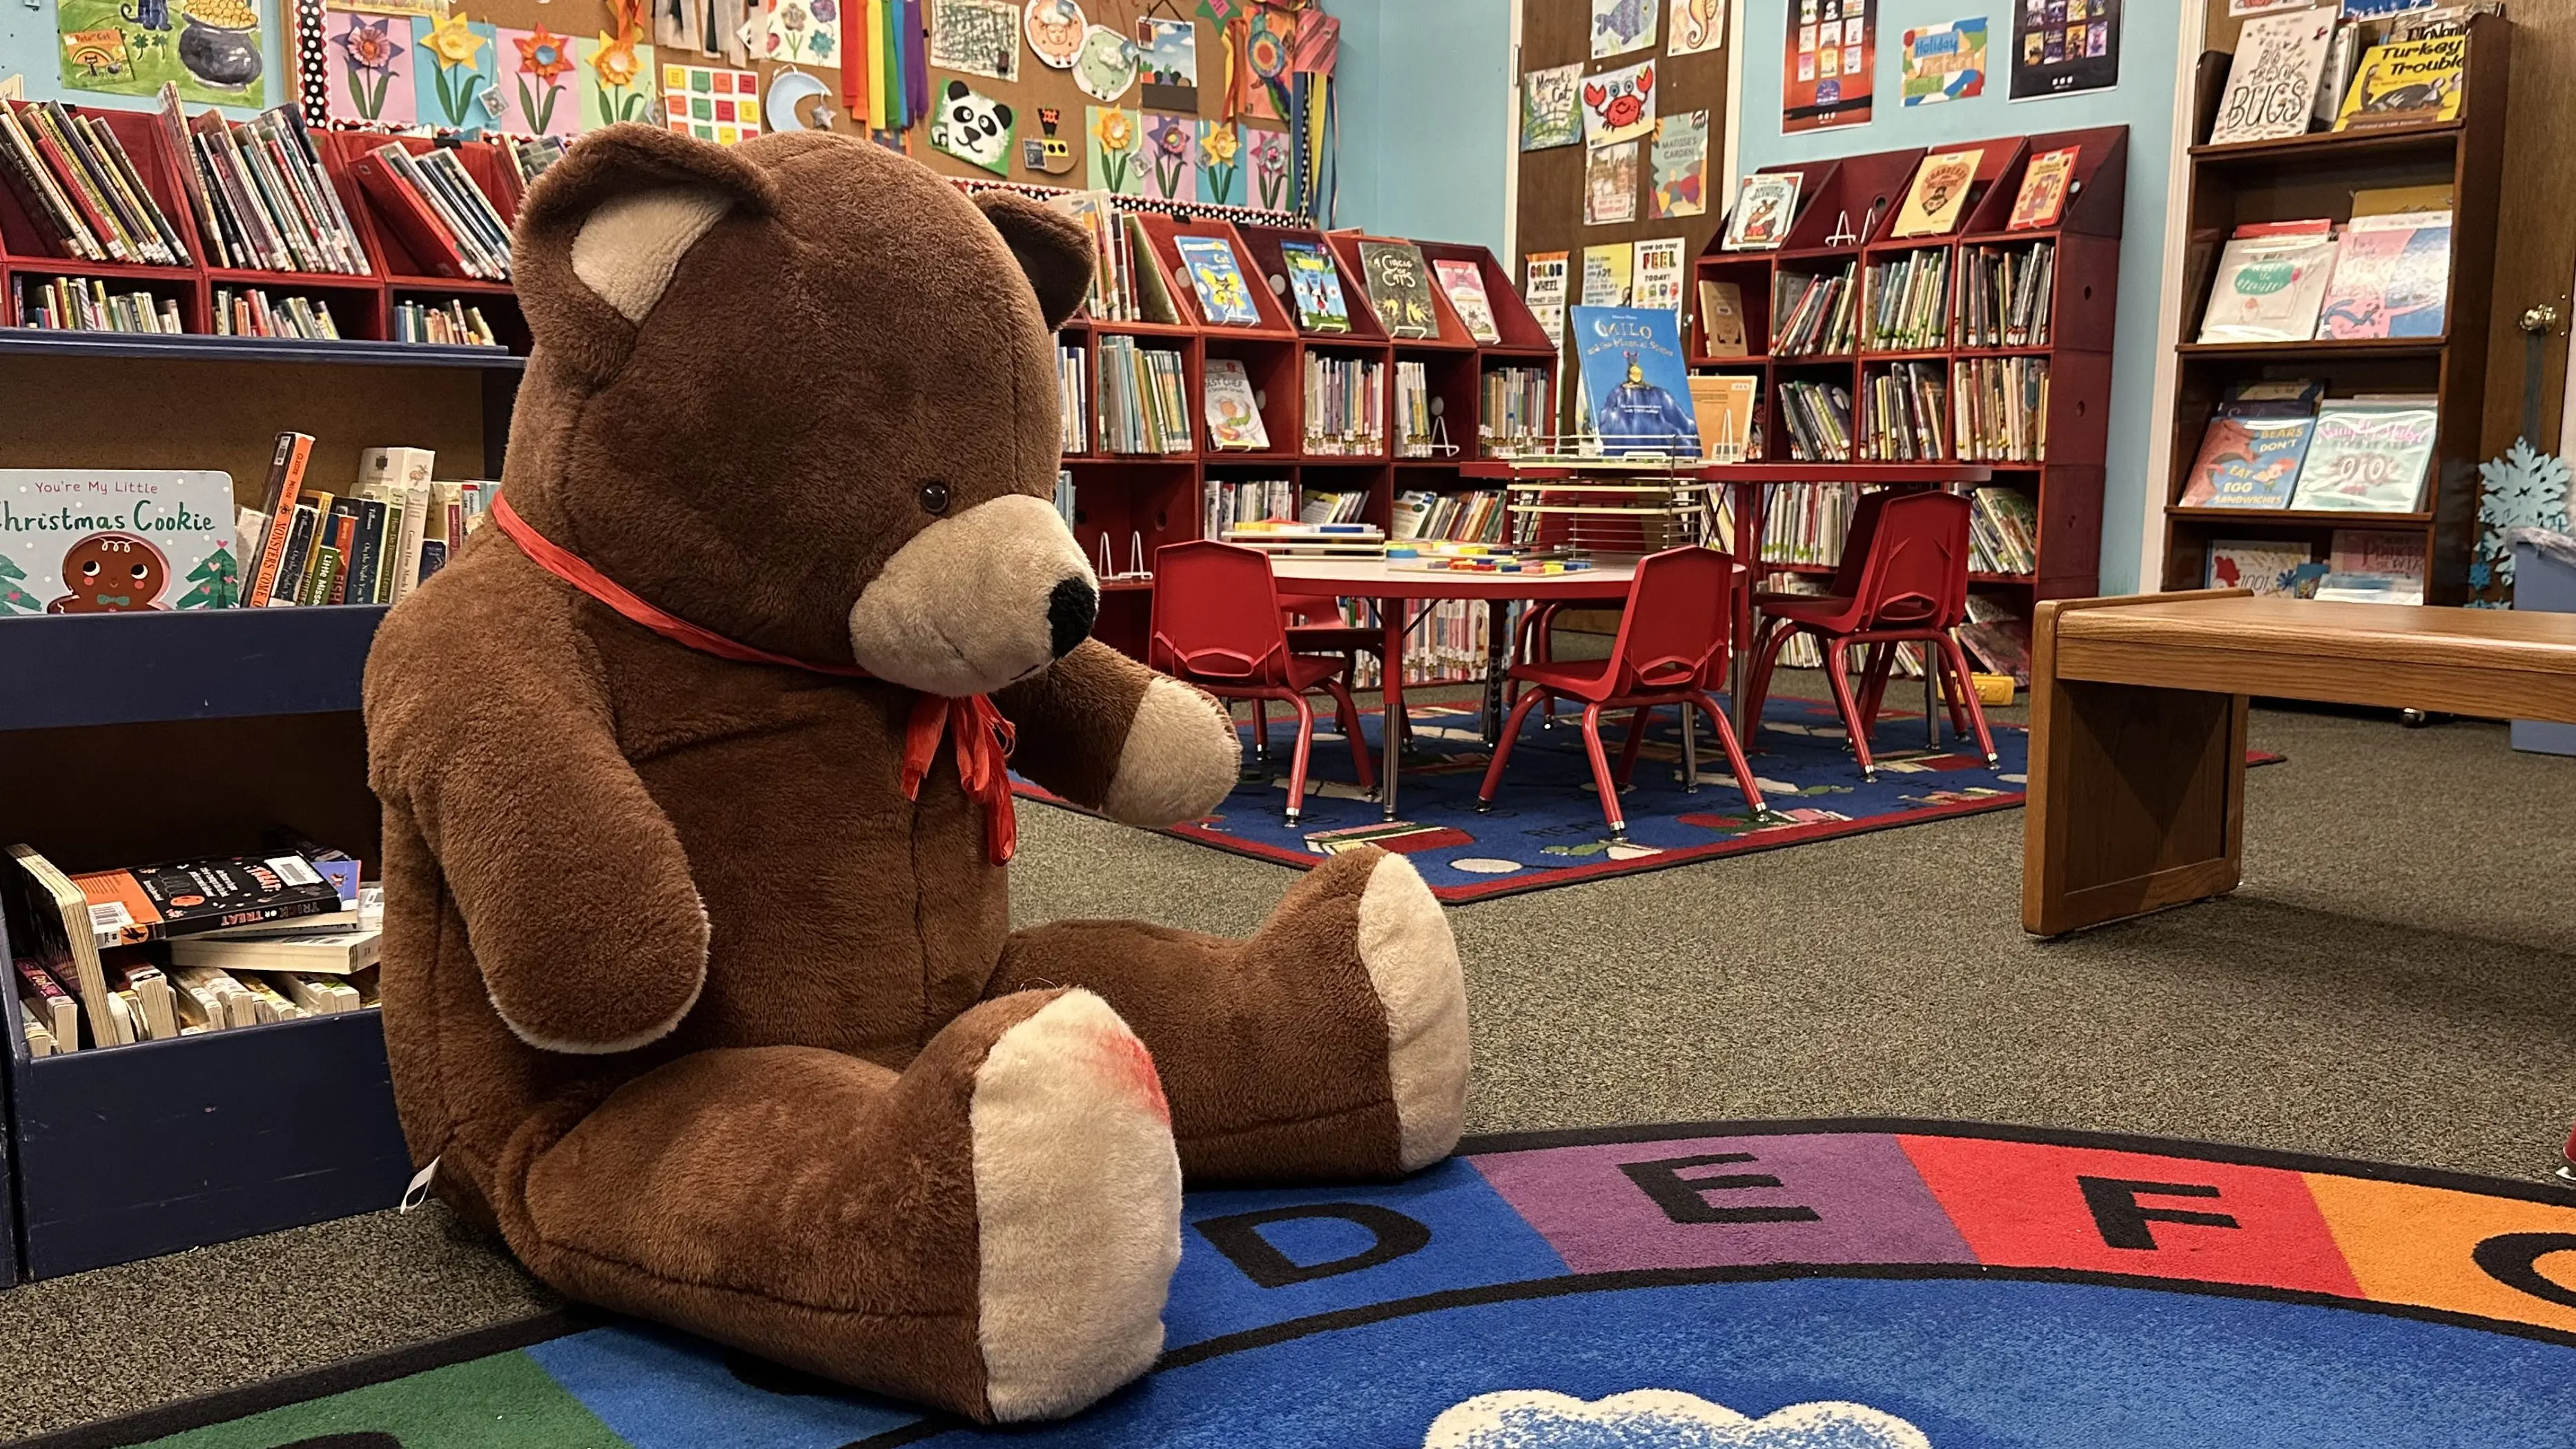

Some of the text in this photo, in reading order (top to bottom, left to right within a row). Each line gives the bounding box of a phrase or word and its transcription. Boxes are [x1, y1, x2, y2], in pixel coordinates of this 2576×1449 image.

[1915, 36, 1958, 57] Holiday
[2382, 39, 2463, 59] Turkey
[1551, 84, 1572, 103] Cat
[2226, 79, 2307, 129] BUGS
[1643, 251, 1677, 270] FEEL
[1530, 263, 1563, 278] COLOR
[1534, 280, 1559, 293] WHEEL
[1594, 320, 1652, 340] MILO
[2261, 427, 2303, 440] BEARS
[2259, 439, 2297, 453] DON'T
[2229, 465, 2254, 478] EAT
[35, 481, 158, 494] You're My Little
[2223, 482, 2254, 493] EGG
[2214, 495, 2283, 505] SANDWICHES
[0, 499, 216, 532] hristmas Cookie
[262, 520, 286, 570] MONSTERS
[319, 554, 333, 578] Little
[255, 571, 272, 598] COME
[329, 574, 344, 602] FISH
[2240, 574, 2270, 592] 1001
[219, 908, 264, 927] TREAT
[277, 900, 320, 918] TRICK
[1193, 1152, 2243, 1289] D E F
